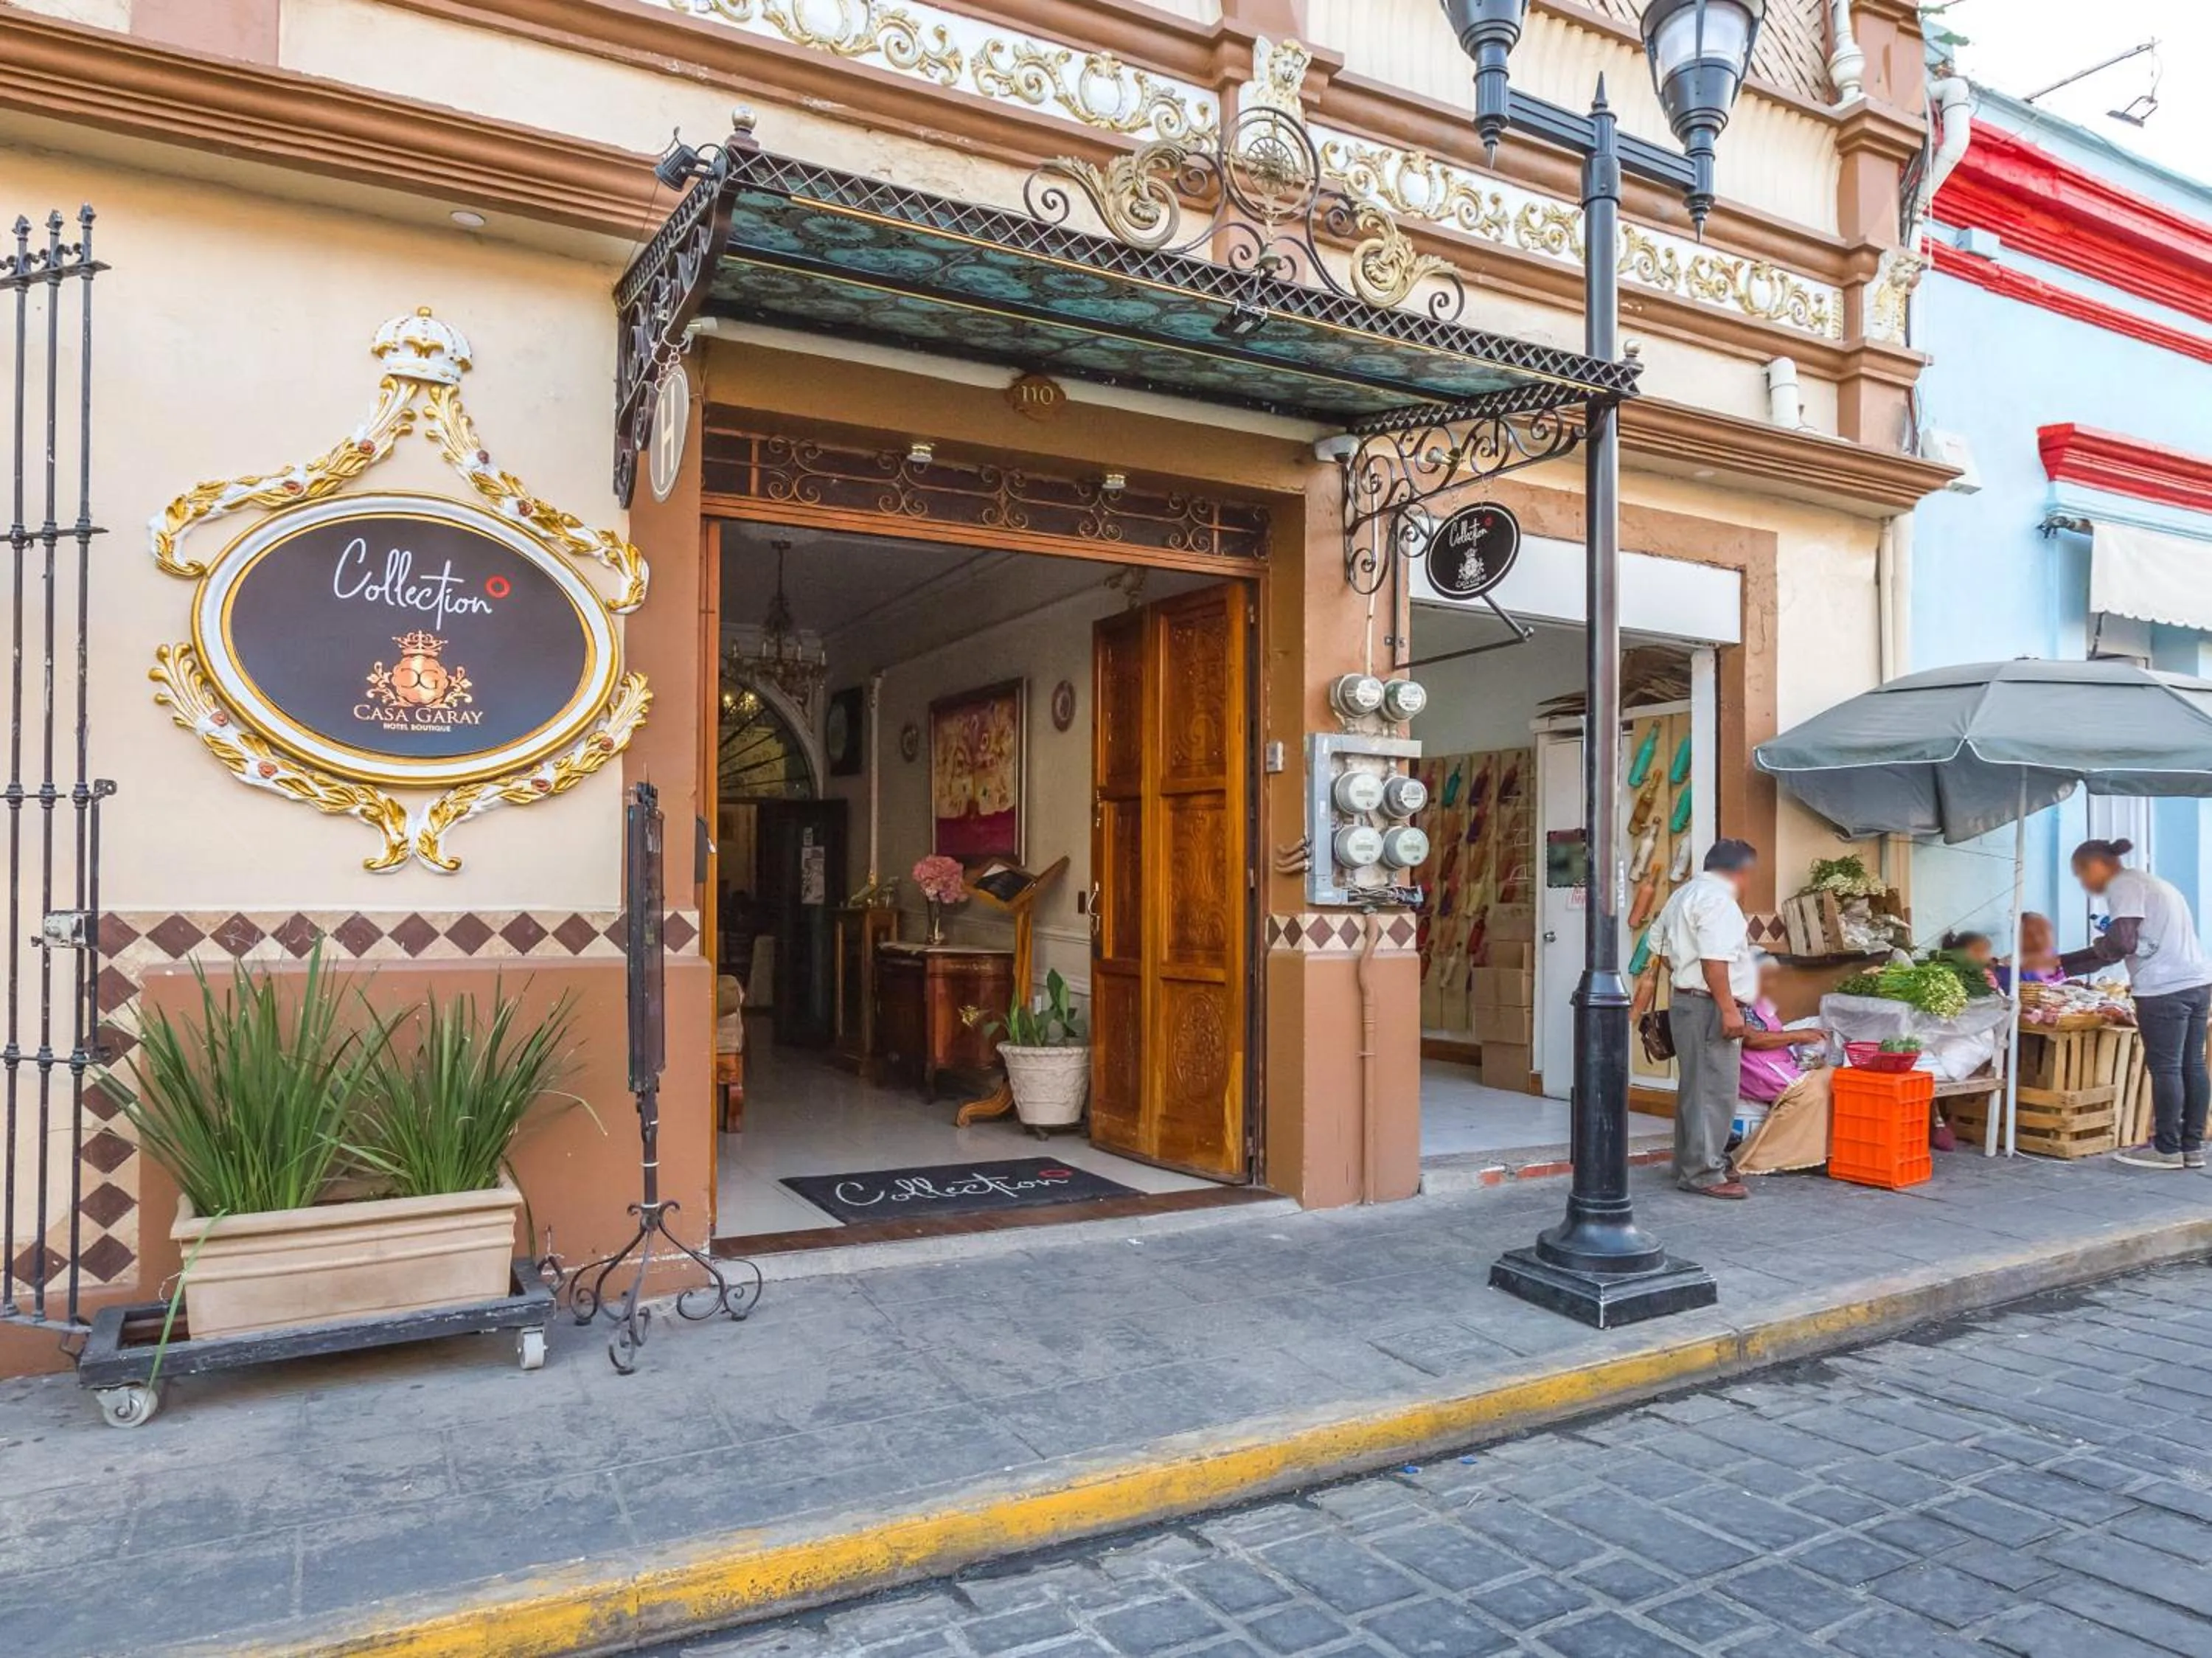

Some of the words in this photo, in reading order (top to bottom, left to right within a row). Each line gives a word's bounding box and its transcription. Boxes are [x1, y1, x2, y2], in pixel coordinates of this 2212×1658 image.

[1021, 386, 1054, 405] 110
[661, 384, 675, 485] H
[1449, 518, 1488, 547] Collection
[333, 538, 493, 631] Collection
[353, 704, 408, 721] CASA
[415, 707, 483, 724] GARAY
[383, 723, 408, 732] HOTEL
[411, 724, 451, 732] BOUTIQUE
[835, 1173, 1068, 1206] Collection
